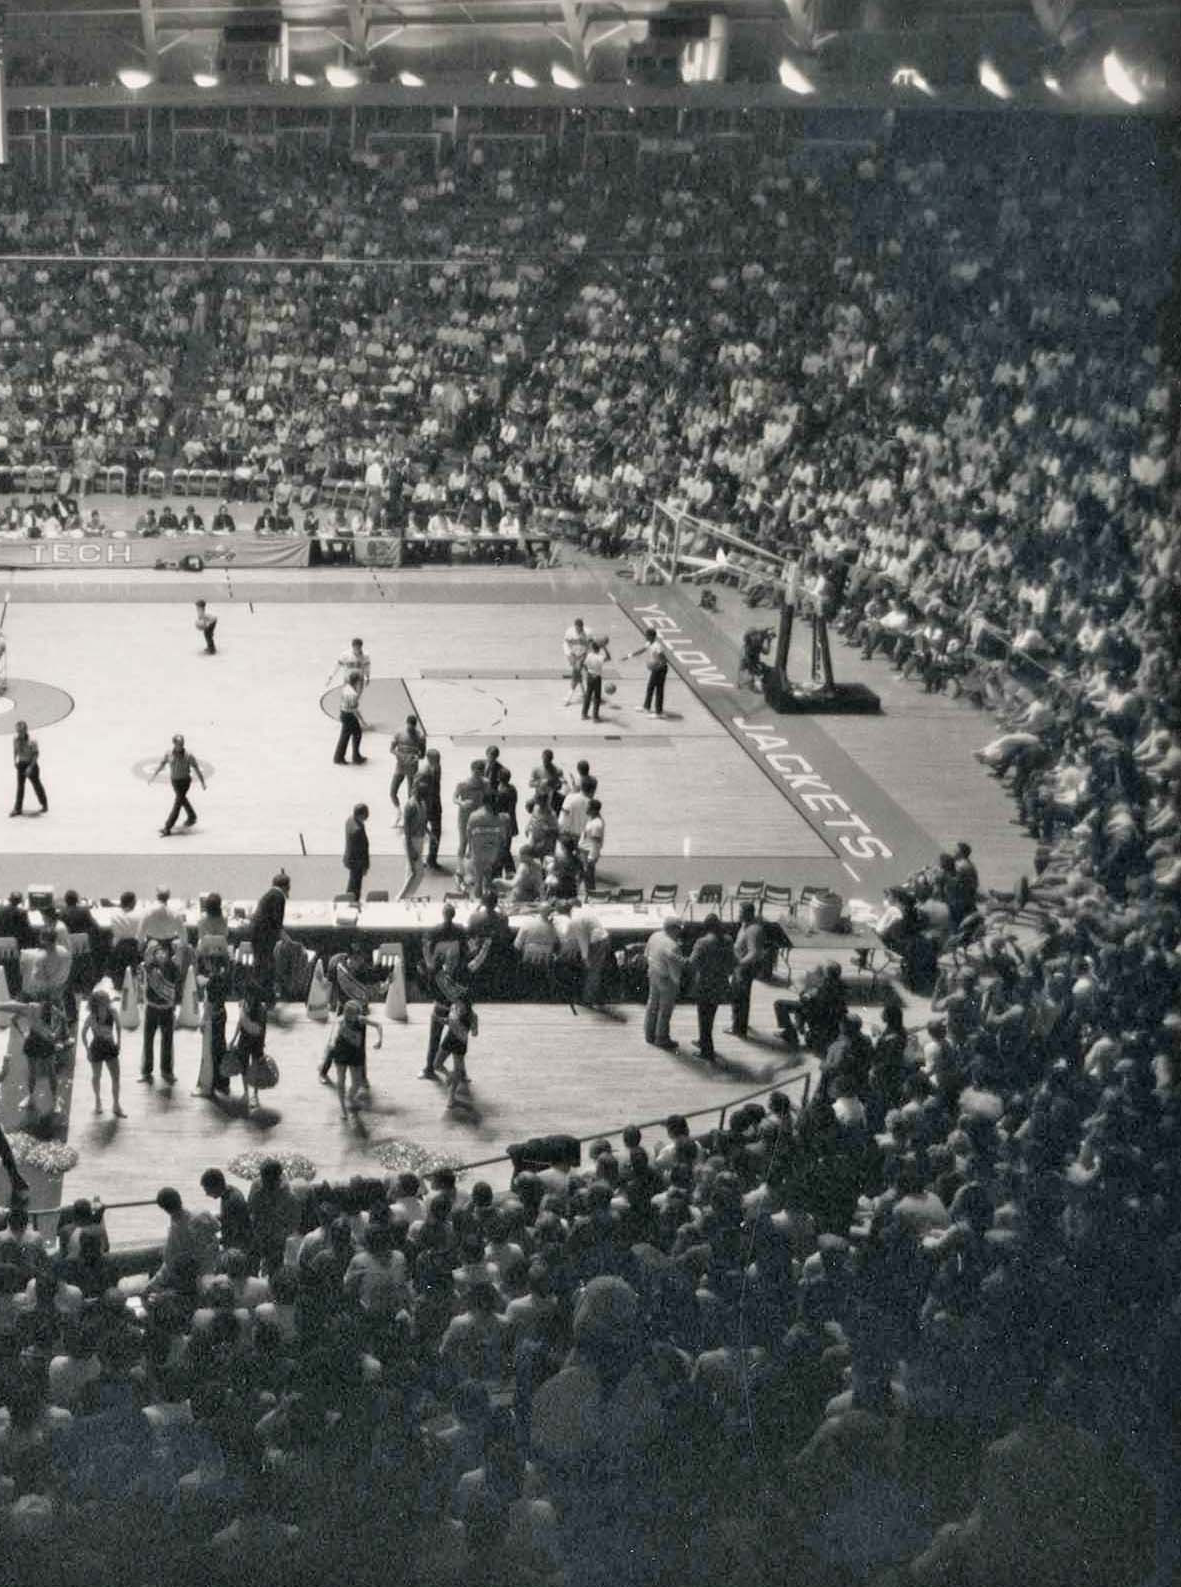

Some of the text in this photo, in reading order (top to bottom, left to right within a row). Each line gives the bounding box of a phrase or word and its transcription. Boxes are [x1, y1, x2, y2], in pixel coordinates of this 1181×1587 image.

[29, 544, 131, 564] TECH
[634, 603, 893, 859] YELLOW JACKETS
